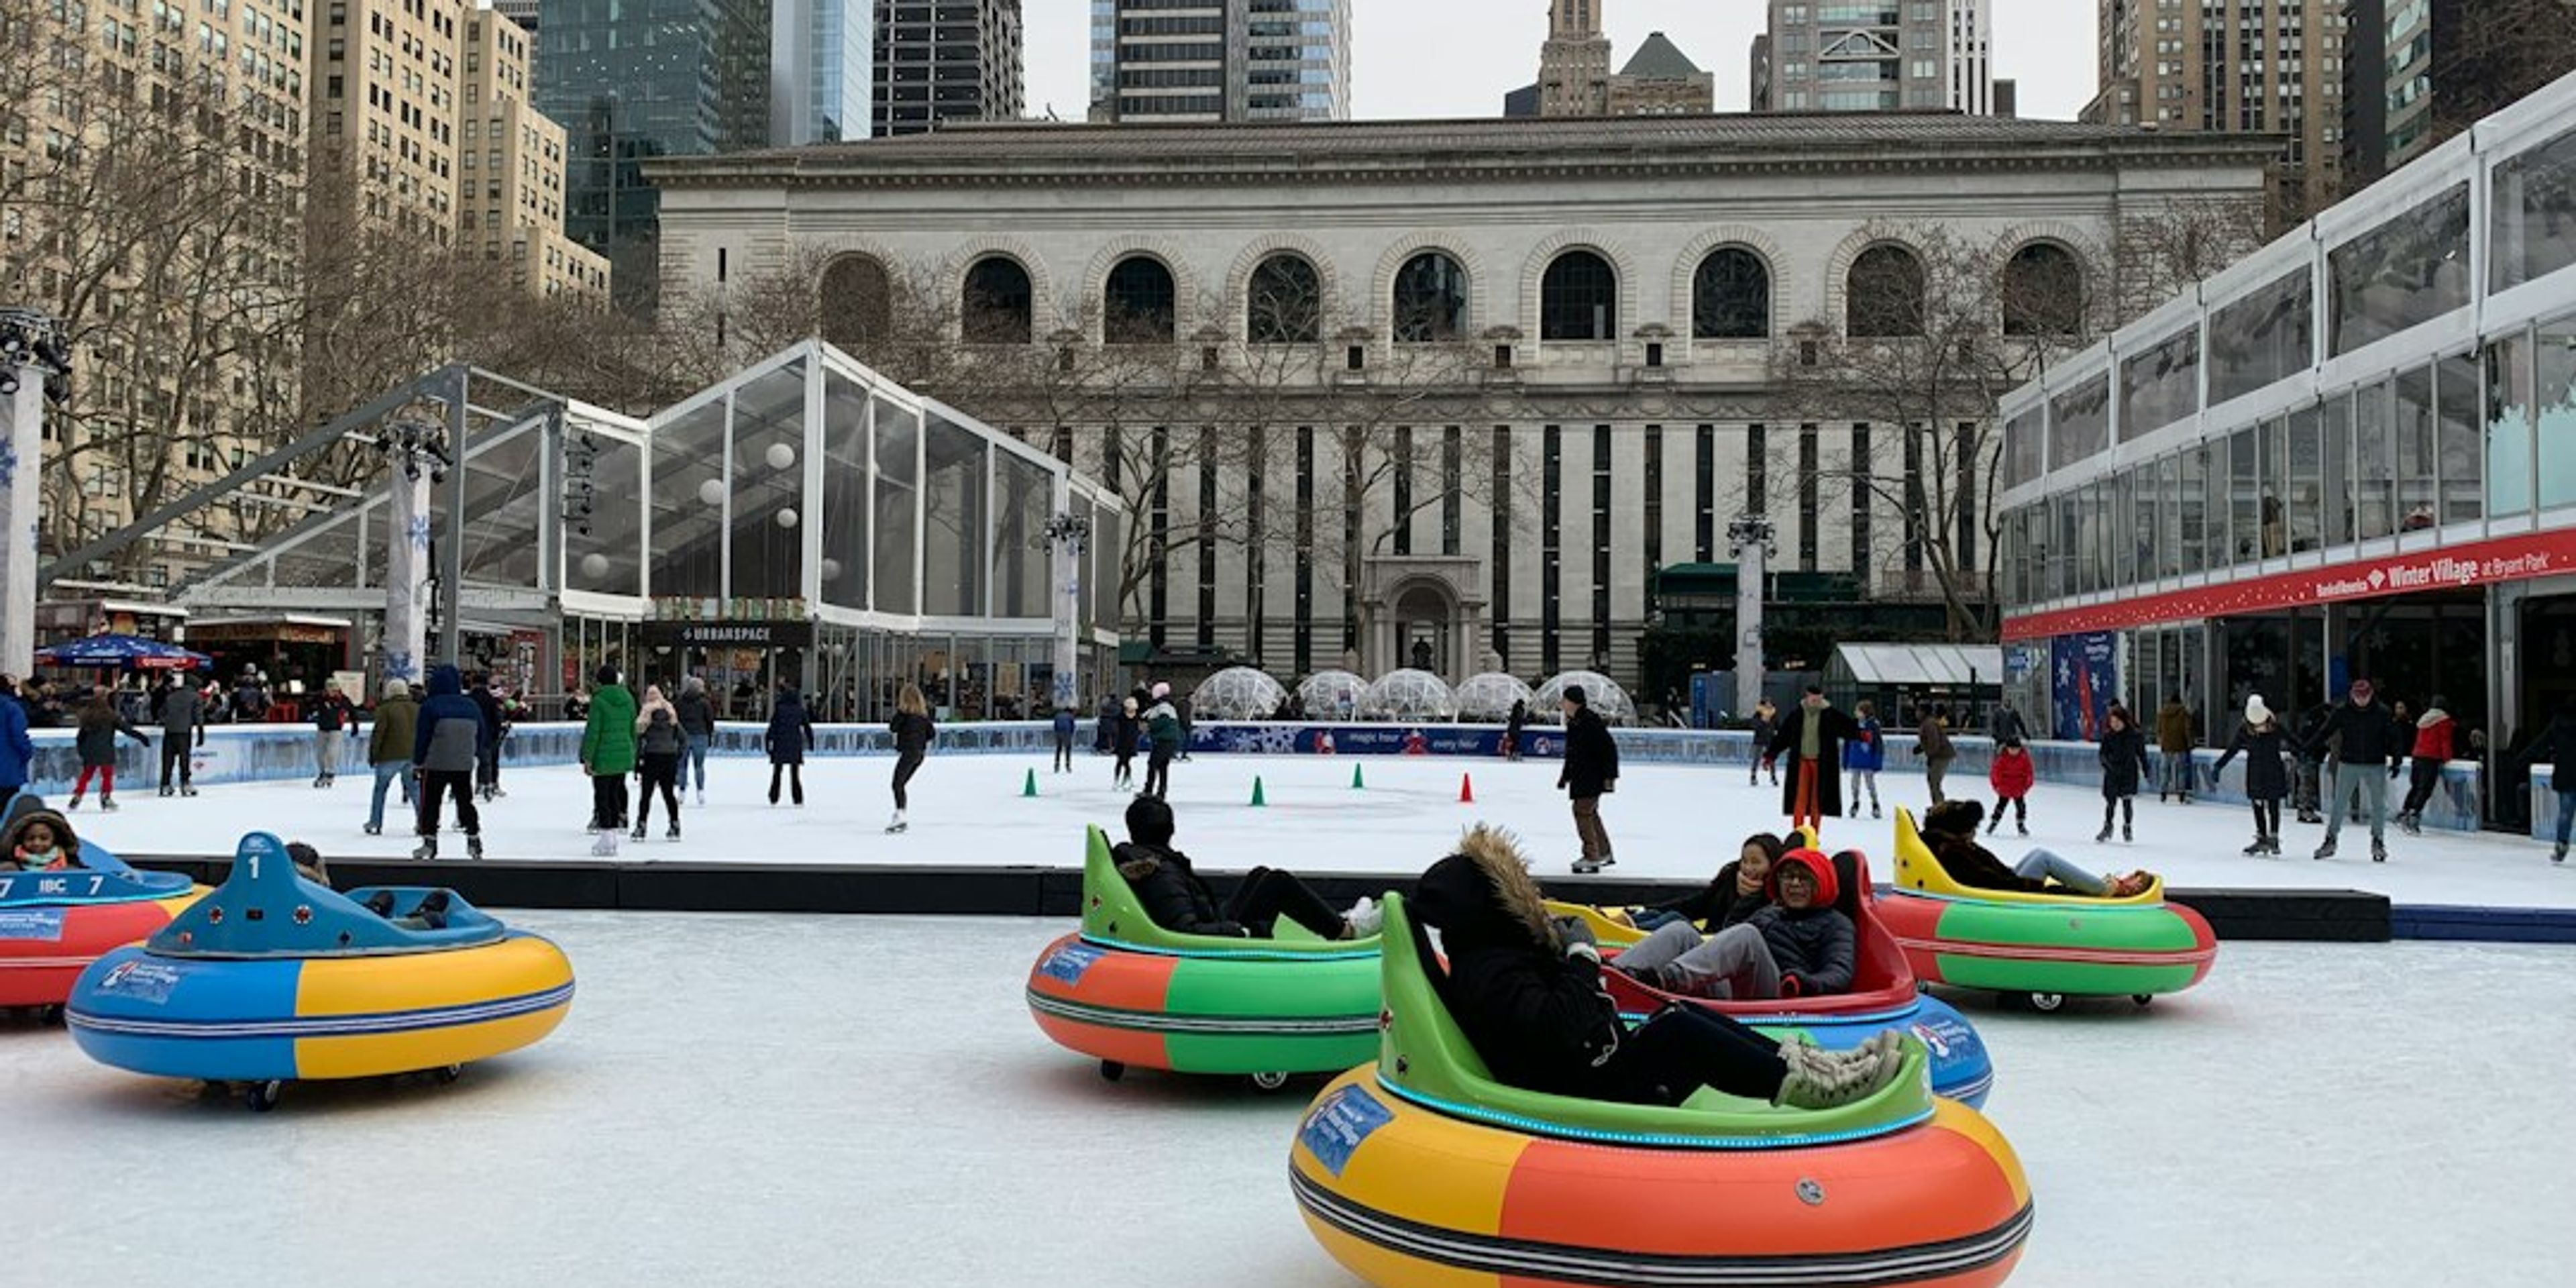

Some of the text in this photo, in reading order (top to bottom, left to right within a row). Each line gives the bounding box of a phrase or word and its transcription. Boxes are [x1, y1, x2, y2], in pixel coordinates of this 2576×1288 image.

[2387, 565, 2431, 588] Winter
[2430, 557, 2478, 585] Village
[2483, 561, 2493, 576] at
[2493, 557, 2525, 578] Bryant
[2526, 552, 2549, 571] Park
[693, 627, 771, 641] URBANSPACE
[249, 856, 259, 879] 1
[0, 875, 103, 898] 7 IBC 7
